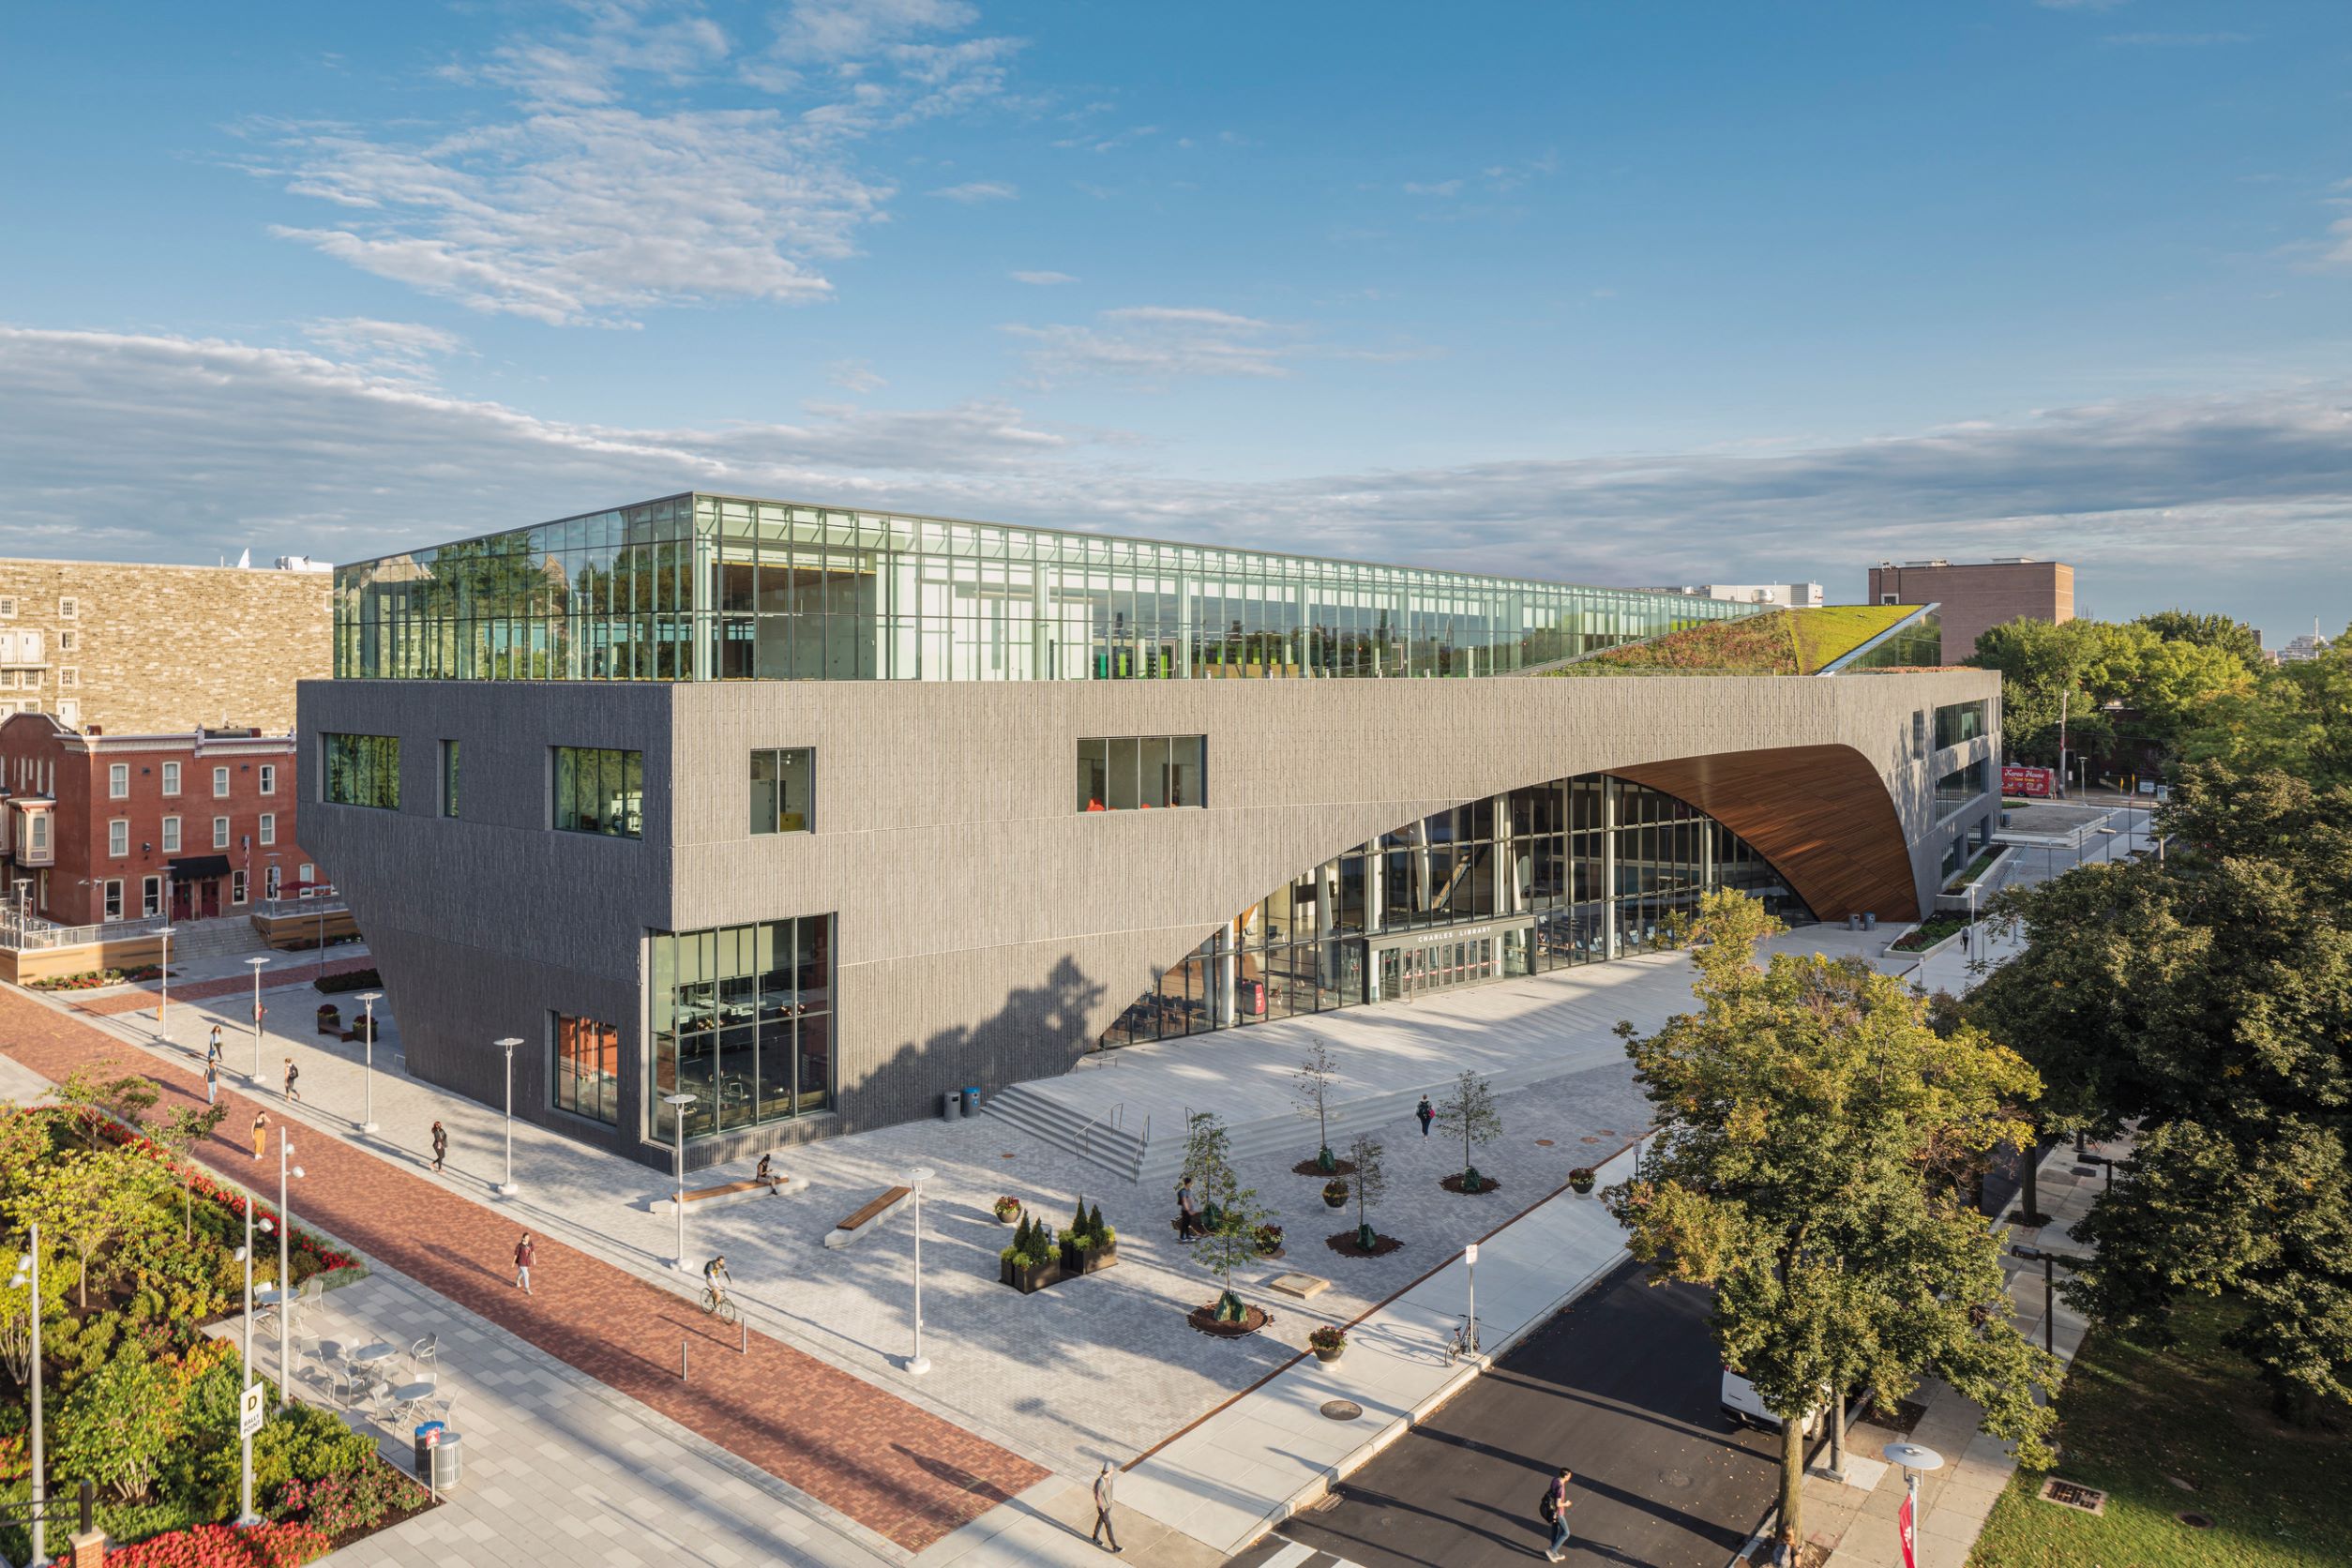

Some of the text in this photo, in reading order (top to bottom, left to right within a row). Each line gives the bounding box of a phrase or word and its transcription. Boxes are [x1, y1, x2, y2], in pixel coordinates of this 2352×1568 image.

[1418, 927, 1491, 942] CHARLES LIBRARY
[249, 1395, 257, 1411] D
[244, 1413, 259, 1426] RALLY
[244, 1419, 260, 1434] POINT
